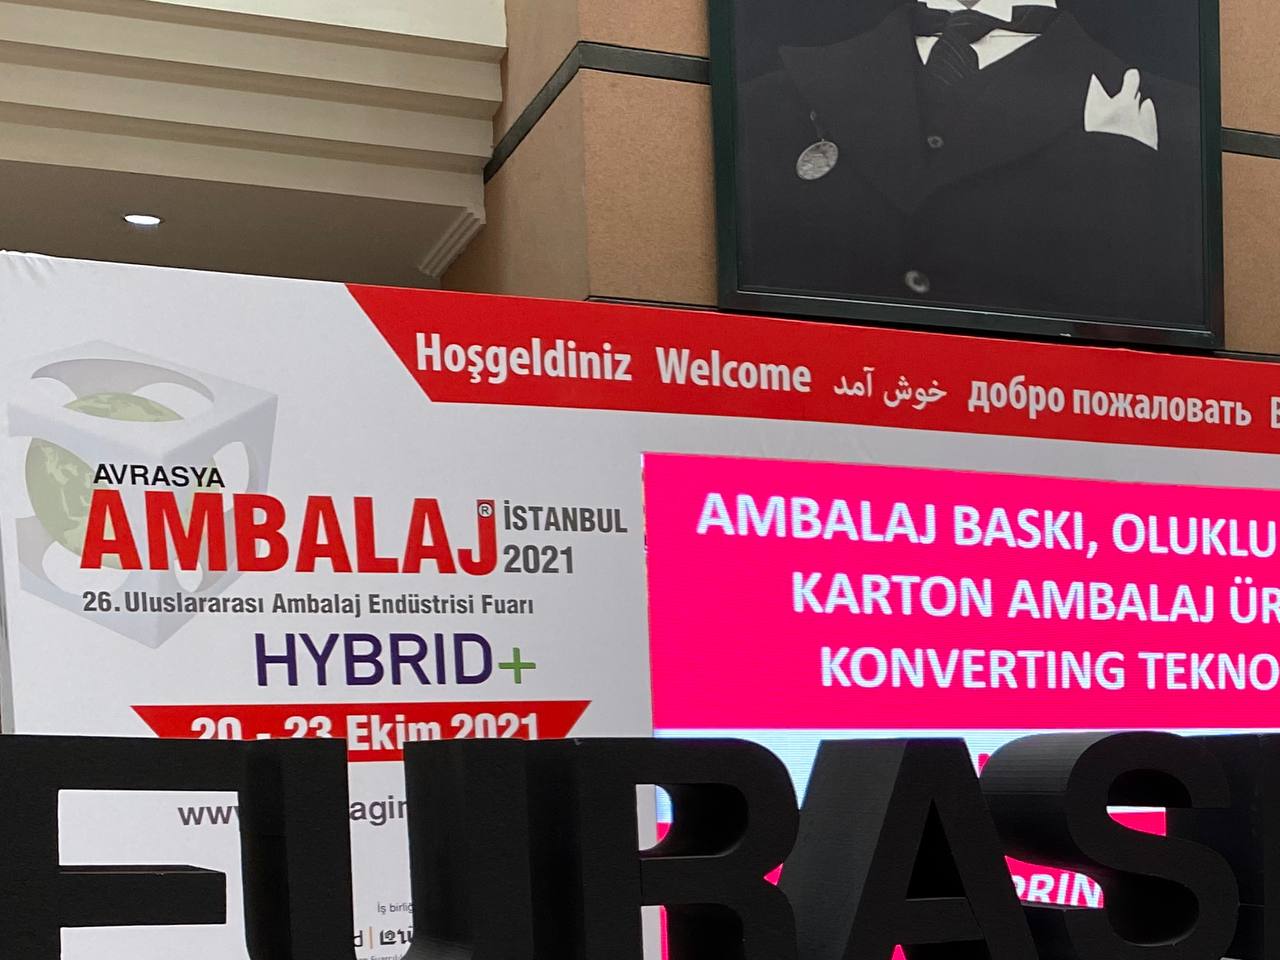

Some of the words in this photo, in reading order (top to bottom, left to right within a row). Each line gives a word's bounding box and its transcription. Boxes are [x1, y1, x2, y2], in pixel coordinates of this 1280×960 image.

[416, 332, 632, 384] Hoşgeldiniz
[655, 346, 812, 393] Welcome
[832, 366, 875, 398] آمد
[882, 375, 948, 409] خوش
[967, 375, 1066, 420] добро
[1072, 388, 1252, 427] пожаловать
[93, 462, 225, 488] AVRASYA
[80, 489, 498, 575] AMBALAJ
[503, 499, 628, 534] İSTANBUL
[697, 492, 938, 547] AMBALAJ
[952, 504, 1099, 561] BASKI,
[1111, 512, 1278, 558] OLUKLU
[503, 544, 575, 574] 2021
[83, 590, 120, 613] 26.
[124, 590, 265, 615] Uluslararası
[272, 592, 362, 618] Ambalaj
[367, 593, 475, 615] Endüstrisi
[479, 595, 534, 616] Fuarı
[791, 572, 993, 618] KARTON
[1008, 580, 1217, 625] AMBALAJ
[820, 647, 1126, 691] KONVERTING
[348, 713, 441, 750] Ekim
[450, 712, 538, 740] 2021
